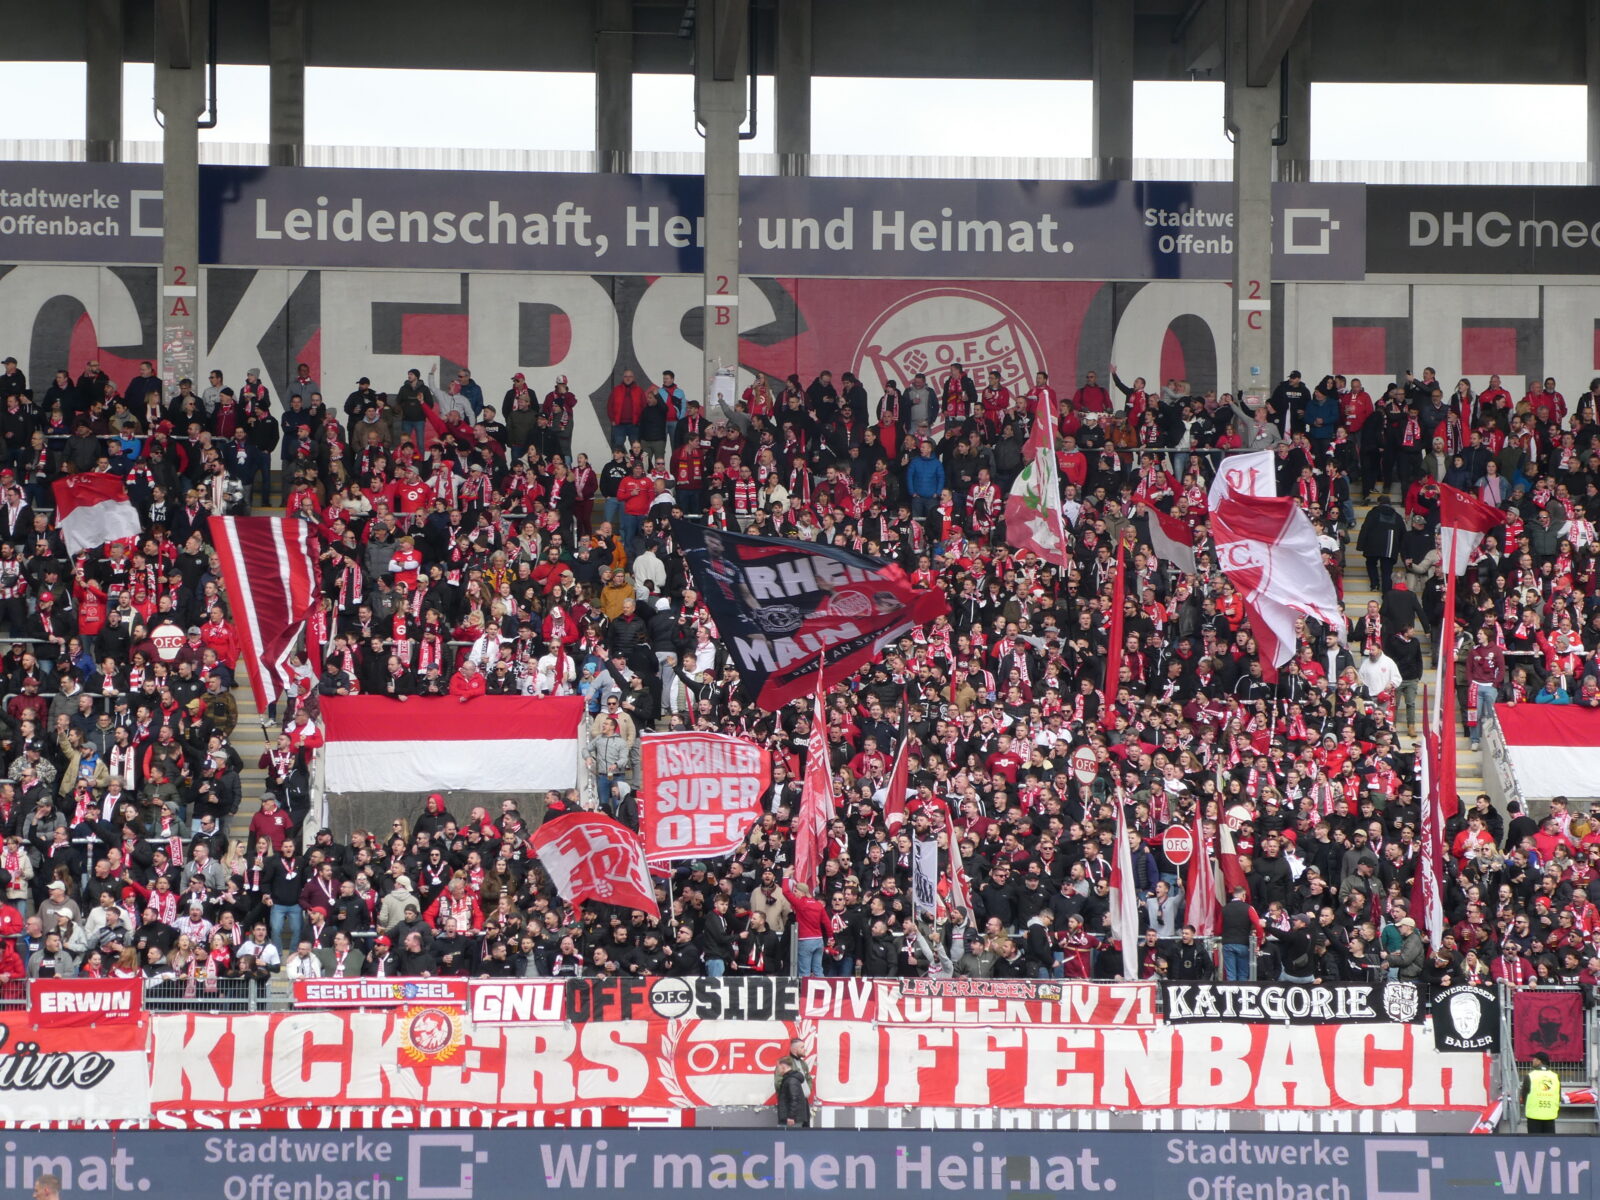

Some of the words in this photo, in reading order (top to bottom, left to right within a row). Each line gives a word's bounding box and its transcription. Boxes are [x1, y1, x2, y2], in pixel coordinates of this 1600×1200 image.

[0, 187, 119, 209] tadtwerke
[0, 214, 119, 236] Offenbach
[255, 195, 608, 258] Leidenschaft,
[757, 207, 854, 251] und
[872, 207, 1075, 254] Heimat.
[1144, 208, 1274, 228] Stadtwe
[1158, 235, 1273, 255] Offenb
[173, 266, 187, 285] 2
[715, 275, 729, 294] 2
[1248, 280, 1261, 299] 2
[170, 297, 190, 317] A
[714, 306, 730, 325] B
[1247, 310, 1262, 329] C
[733, 621, 862, 673] MAIN
[656, 740, 761, 779] ASOZIALER
[656, 777, 761, 813] SUPER
[656, 811, 757, 848] OFC
[40, 990, 131, 1013] ERWIN
[566, 976, 646, 1023] OFF
[652, 991, 691, 1004] O.F.C.
[694, 976, 800, 1021] SIDE
[900, 978, 1037, 999] LEVERKUSEN
[1167, 984, 1377, 1020] KATEGORIE
[1434, 985, 1496, 1003] UNVERGESSEN
[472, 984, 565, 1022] GNU
[1110, 985, 1155, 1025] 71
[151, 1011, 650, 1105] KICKERS
[816, 1020, 1488, 1107] OFFENBACH
[204, 1135, 391, 1163] Stadtwerke
[1167, 1139, 1349, 1166] Stadtwerke
[4, 1141, 150, 1192] imat.
[540, 1140, 637, 1189] Wir
[653, 1141, 876, 1190] machen
[1495, 1147, 1590, 1195] Wir
[224, 1174, 391, 1200] Offenbach
[1187, 1176, 1349, 1200] Offenbach
